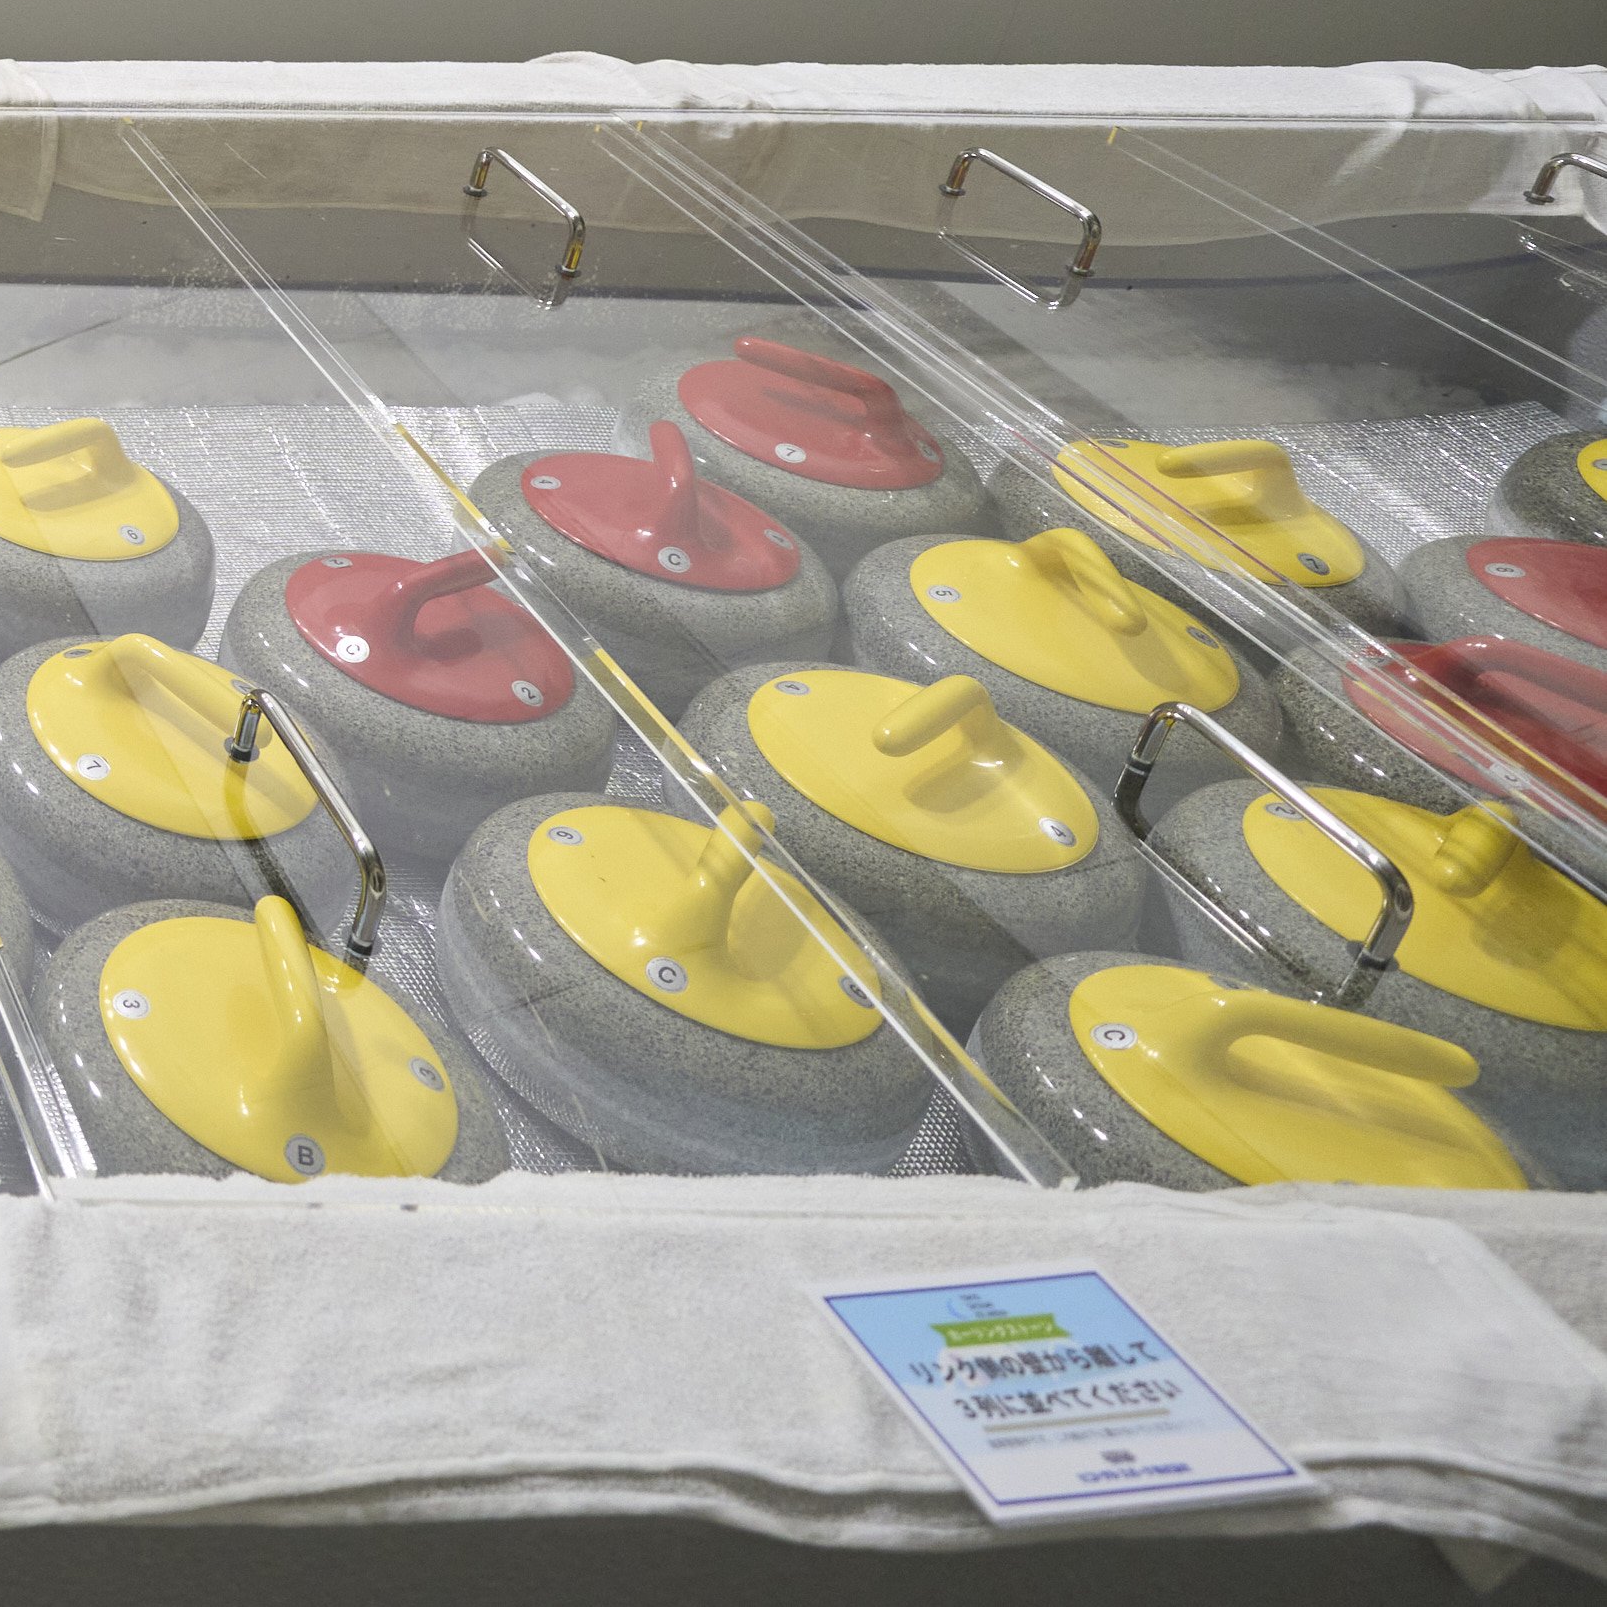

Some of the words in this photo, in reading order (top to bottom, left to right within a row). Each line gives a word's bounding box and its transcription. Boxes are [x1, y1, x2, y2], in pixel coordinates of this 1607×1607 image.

[658, 966, 677, 984] C
[1104, 1029, 1126, 1042] C
[297, 1145, 314, 1167] B
